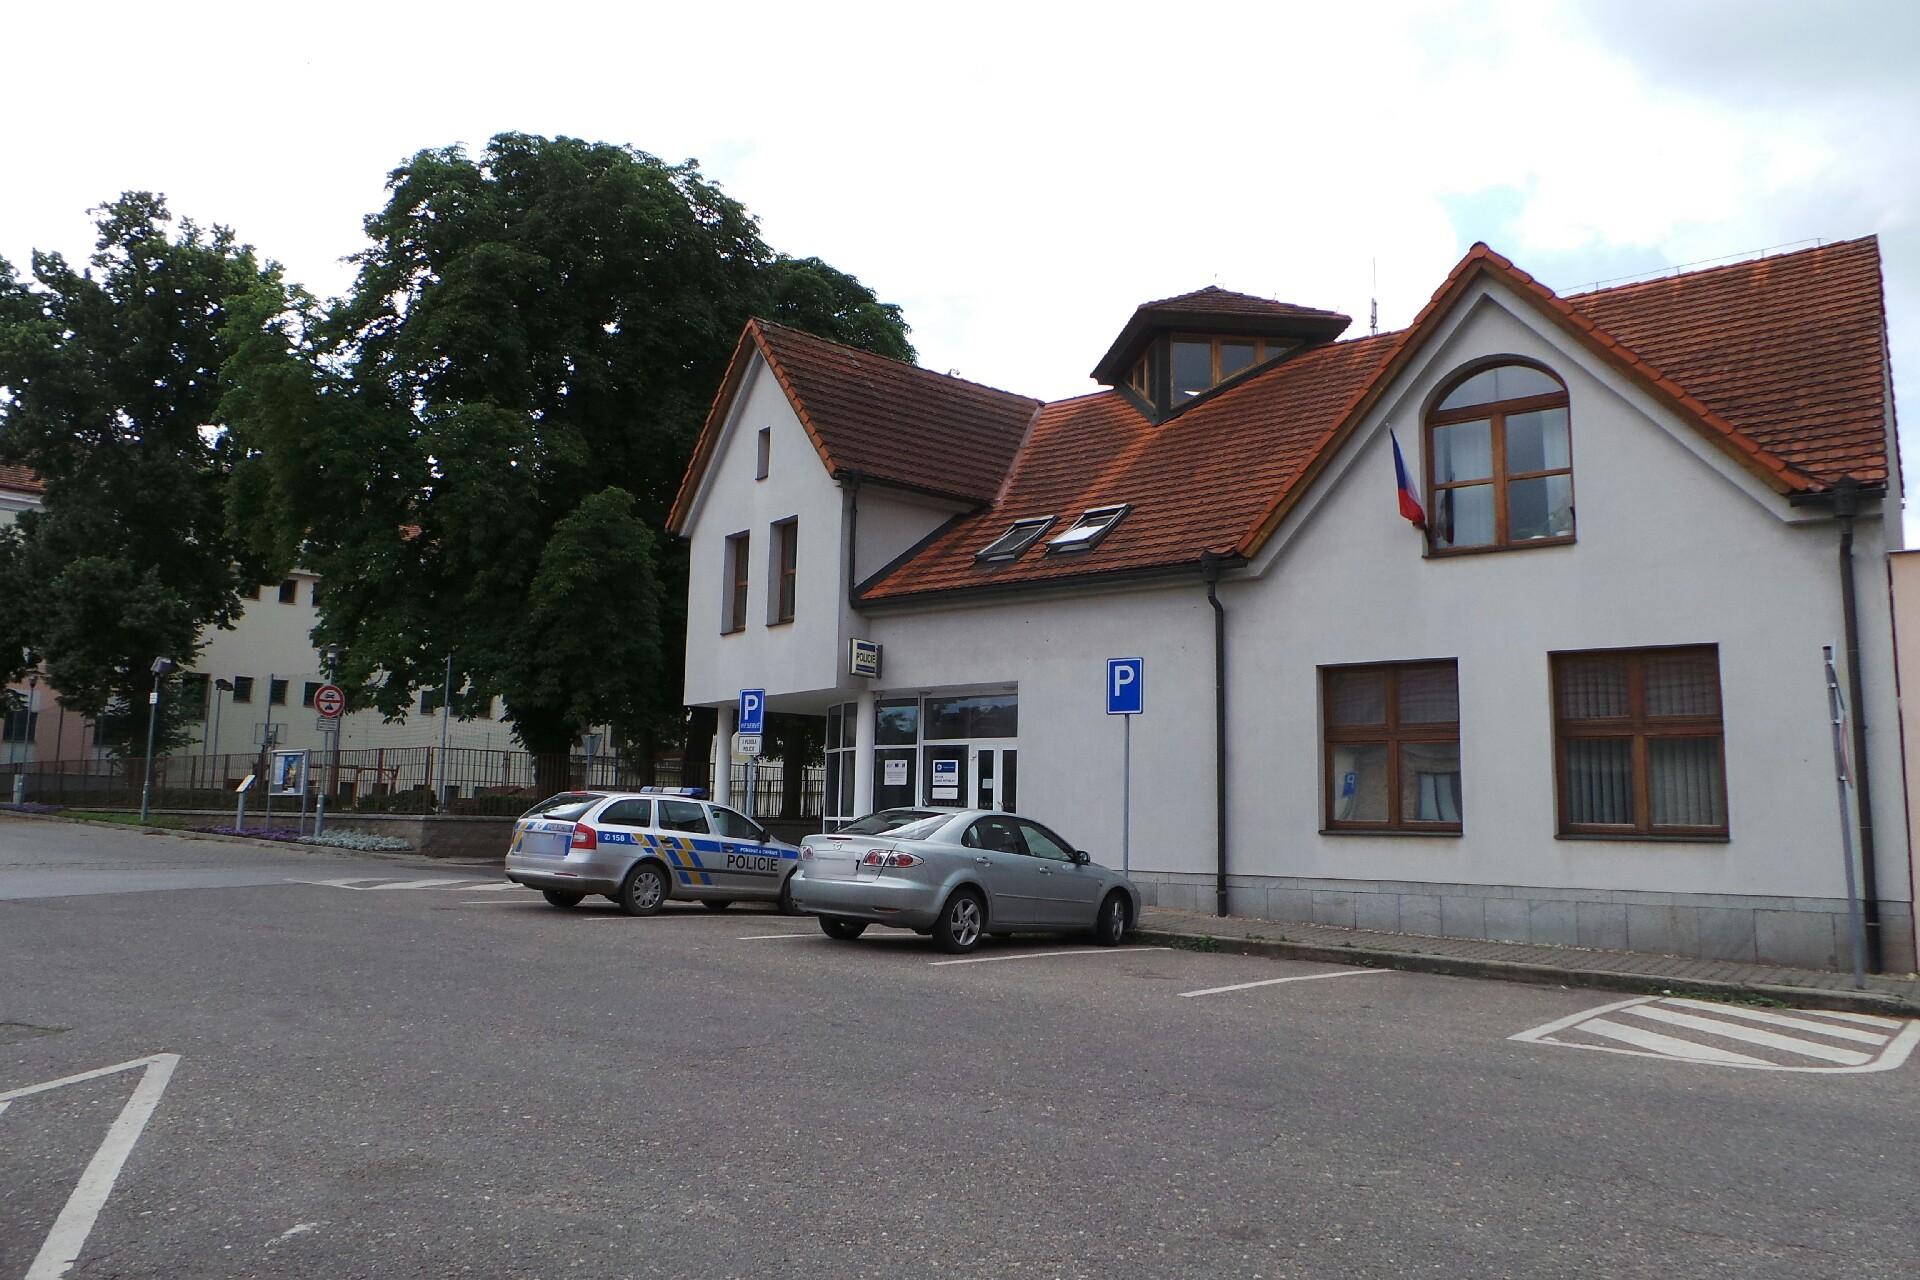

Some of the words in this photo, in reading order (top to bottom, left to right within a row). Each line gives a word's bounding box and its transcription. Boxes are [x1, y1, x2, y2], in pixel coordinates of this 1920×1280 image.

[856, 652, 876, 664] POLICIE
[1114, 665, 1135, 697] P
[744, 694, 759, 721] P
[612, 834, 626, 842] 158
[726, 854, 778, 872] POLICIE
